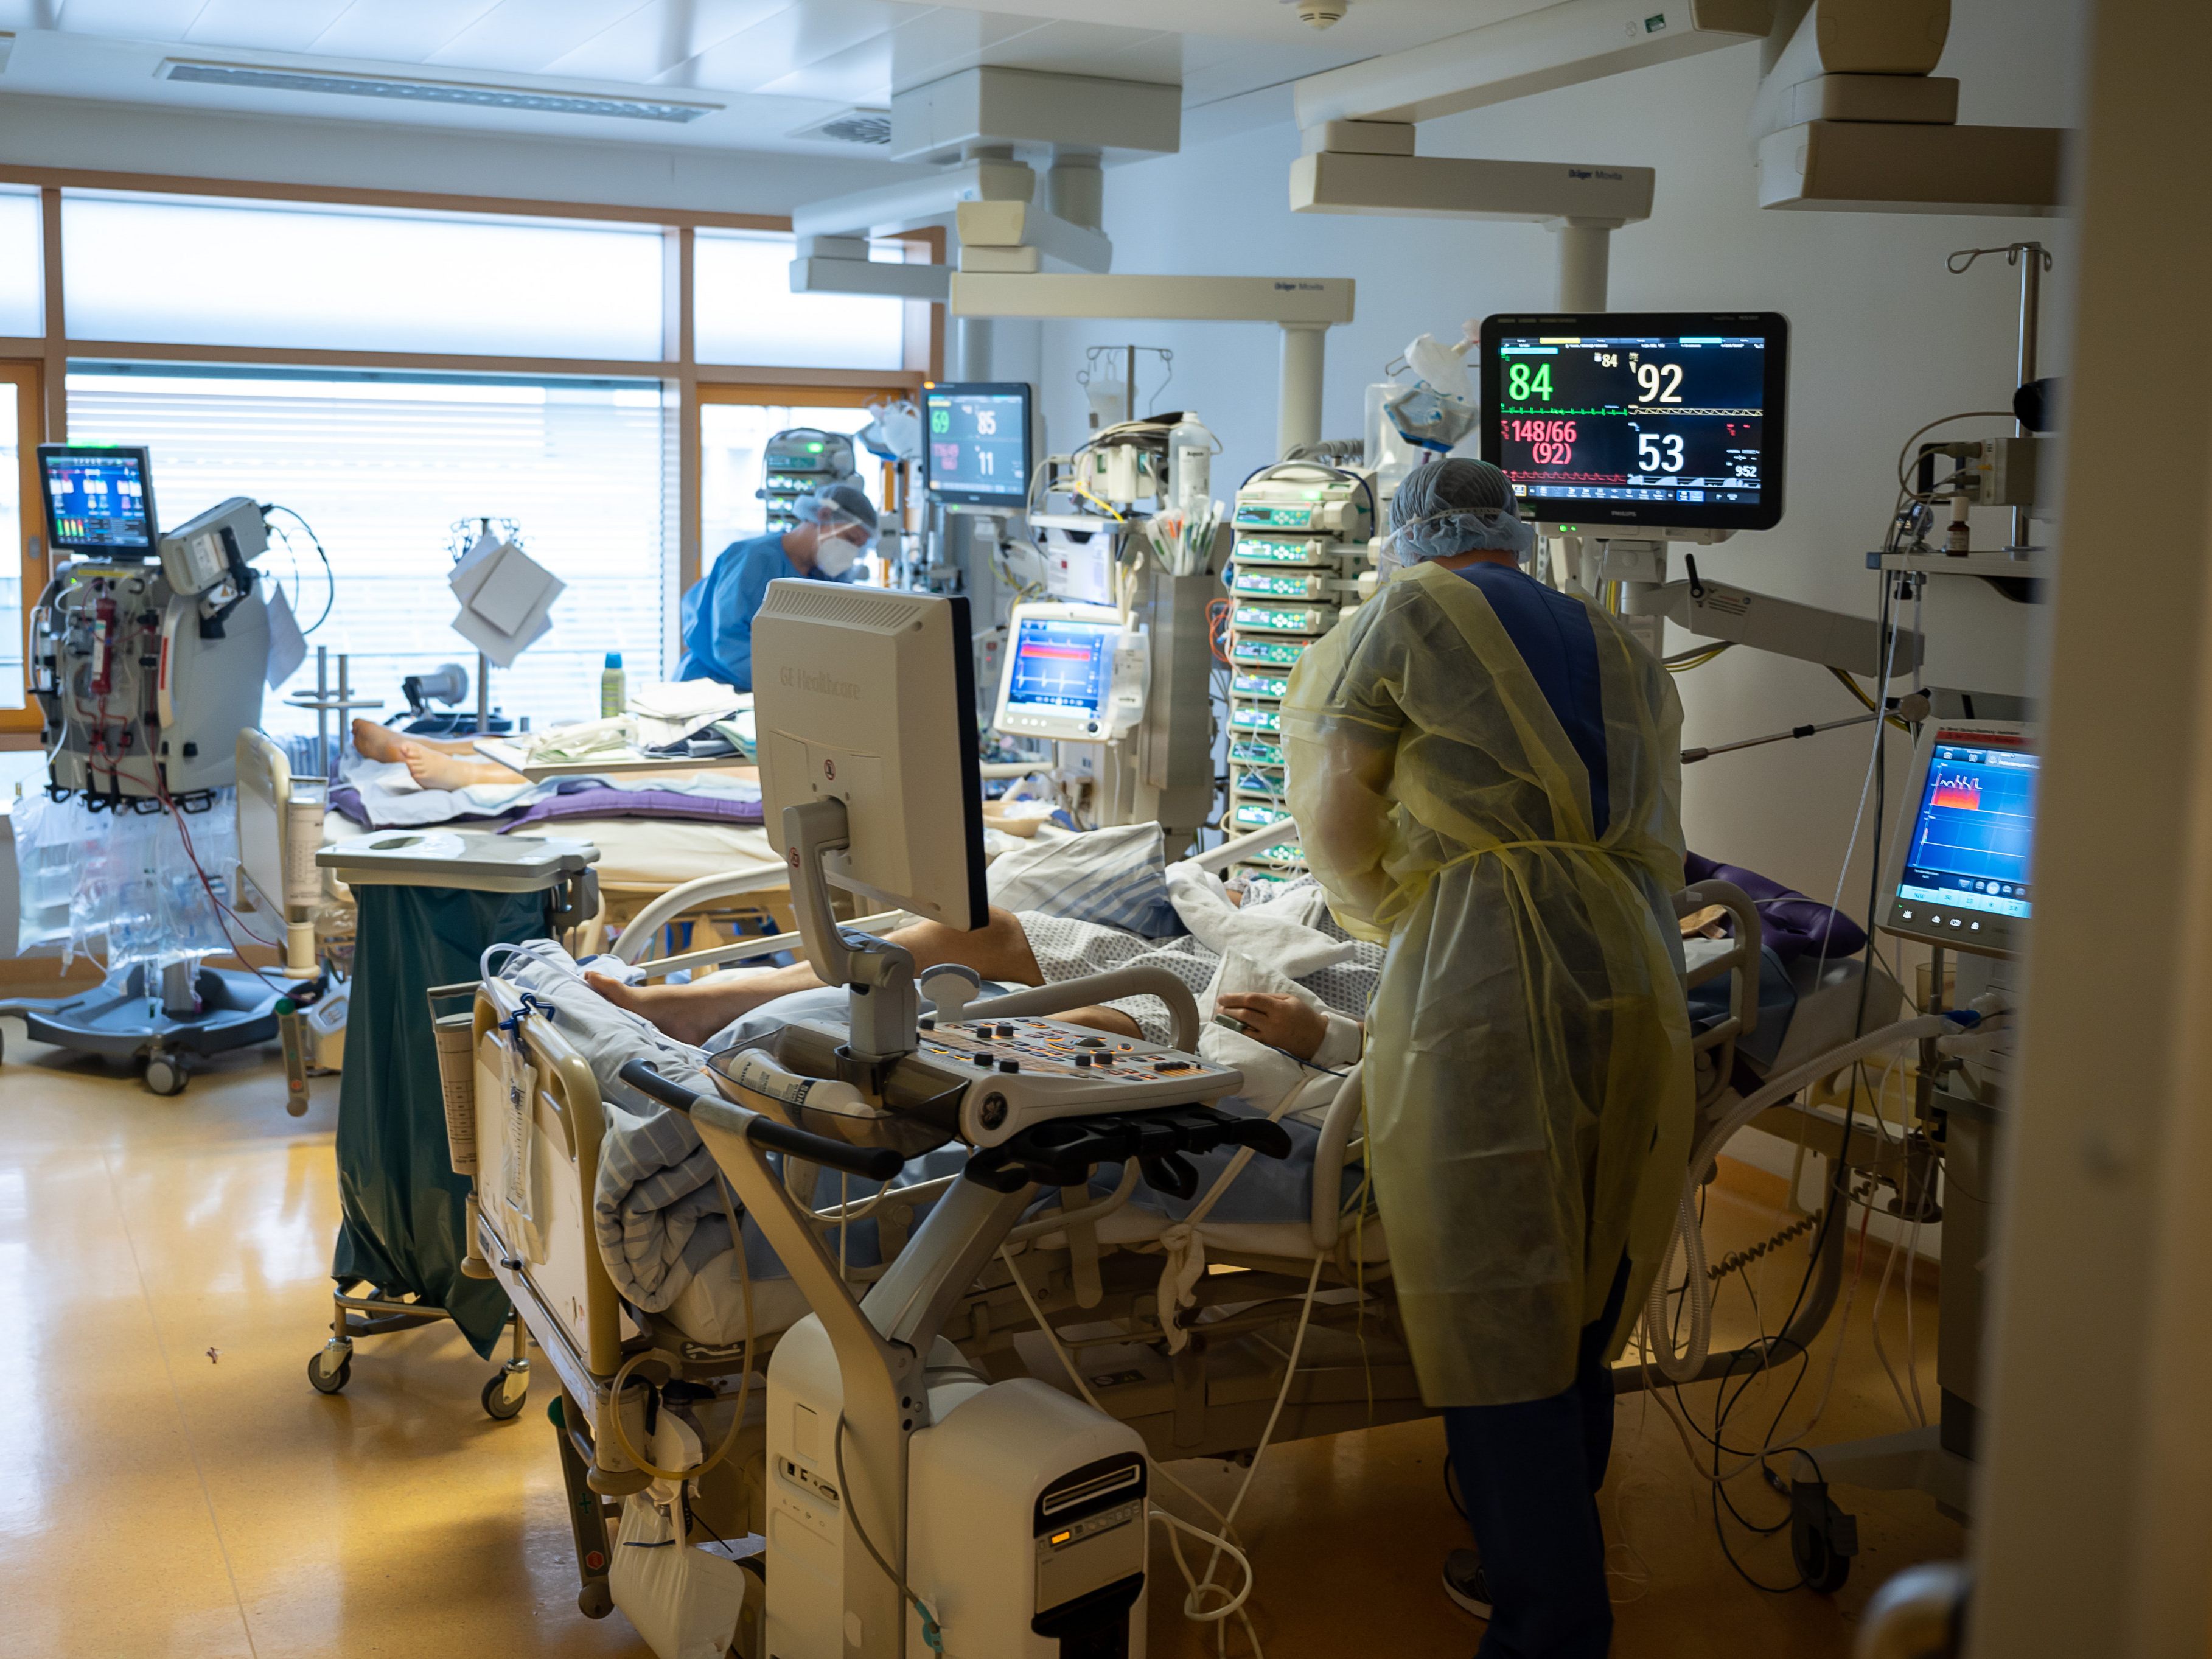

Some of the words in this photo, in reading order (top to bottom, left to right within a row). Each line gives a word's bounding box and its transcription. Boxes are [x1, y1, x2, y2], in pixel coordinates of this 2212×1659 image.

[1602, 354, 1618, 368] 84
[1509, 363, 1554, 401] 84
[1637, 363, 1683, 403] 92
[1511, 420, 1577, 443] 148/66
[978, 451, 994, 475] 11
[1532, 442, 1572, 464] (92)
[1638, 433, 1684, 472] 53
[1735, 465, 1757, 477] 952
[797, 668, 861, 700] Healthcare
